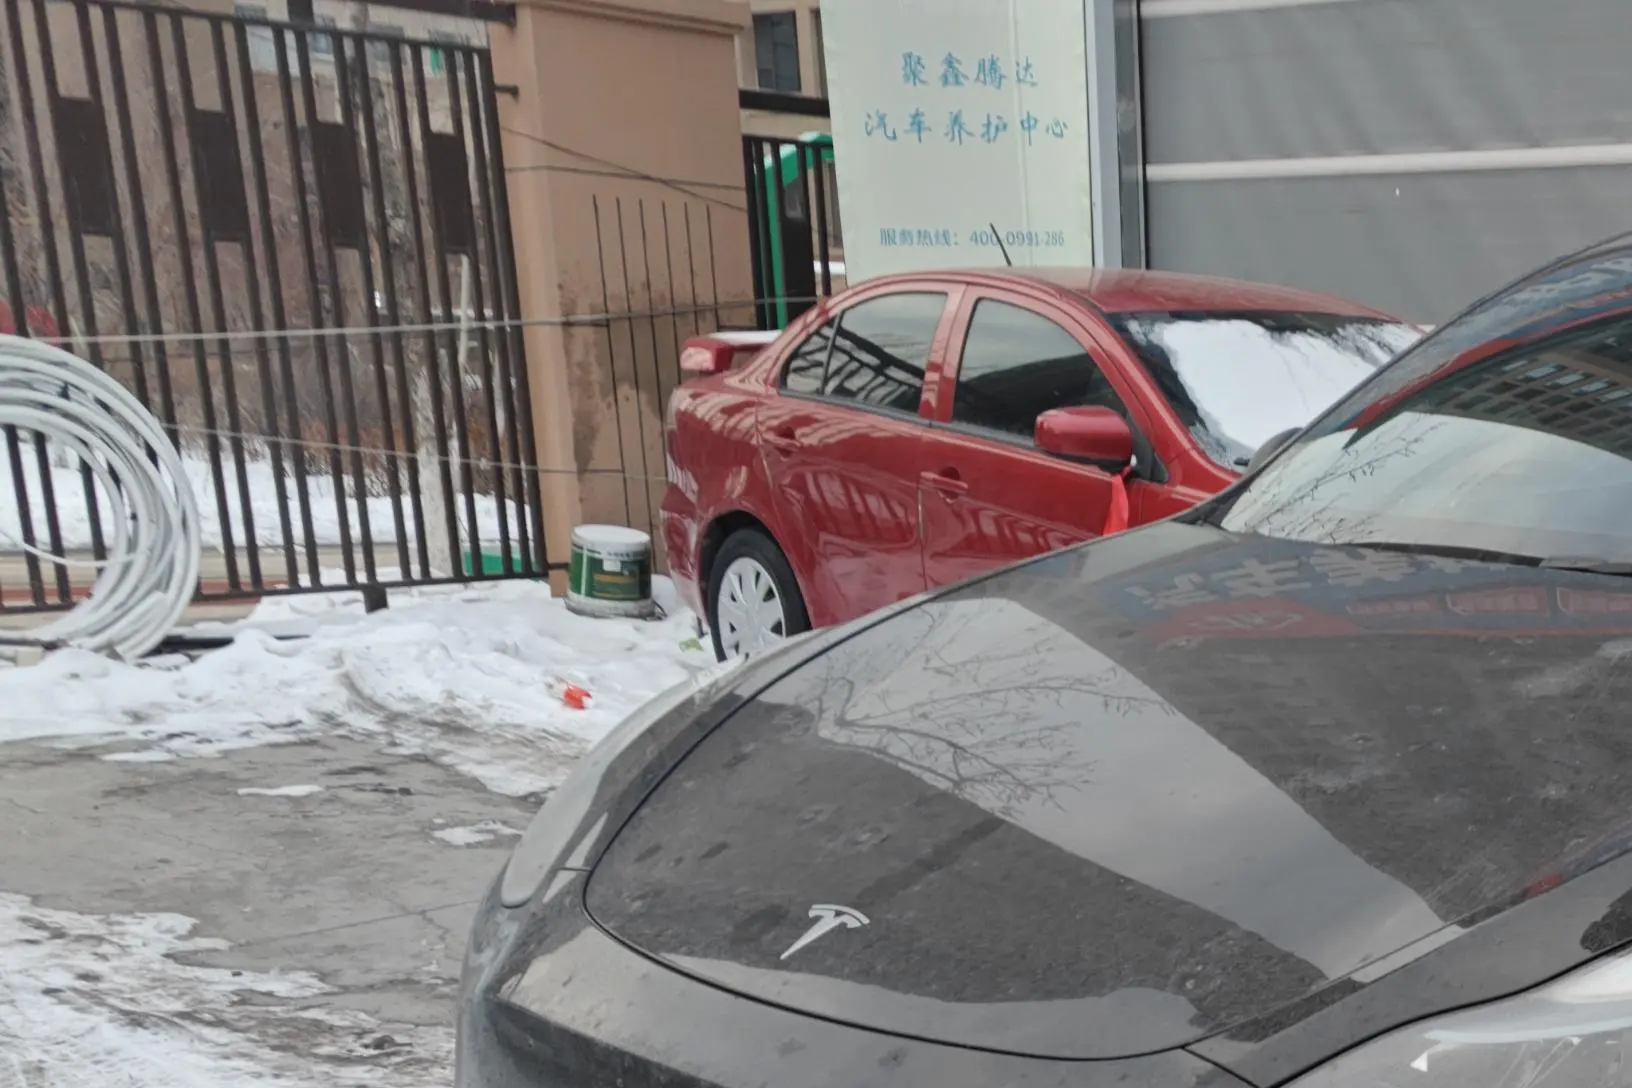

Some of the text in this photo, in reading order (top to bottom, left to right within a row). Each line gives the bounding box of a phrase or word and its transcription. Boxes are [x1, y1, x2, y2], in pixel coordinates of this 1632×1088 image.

[901, 51, 1038, 89] 聚鑫腾达
[865, 107, 1069, 146] 汽车养护中心
